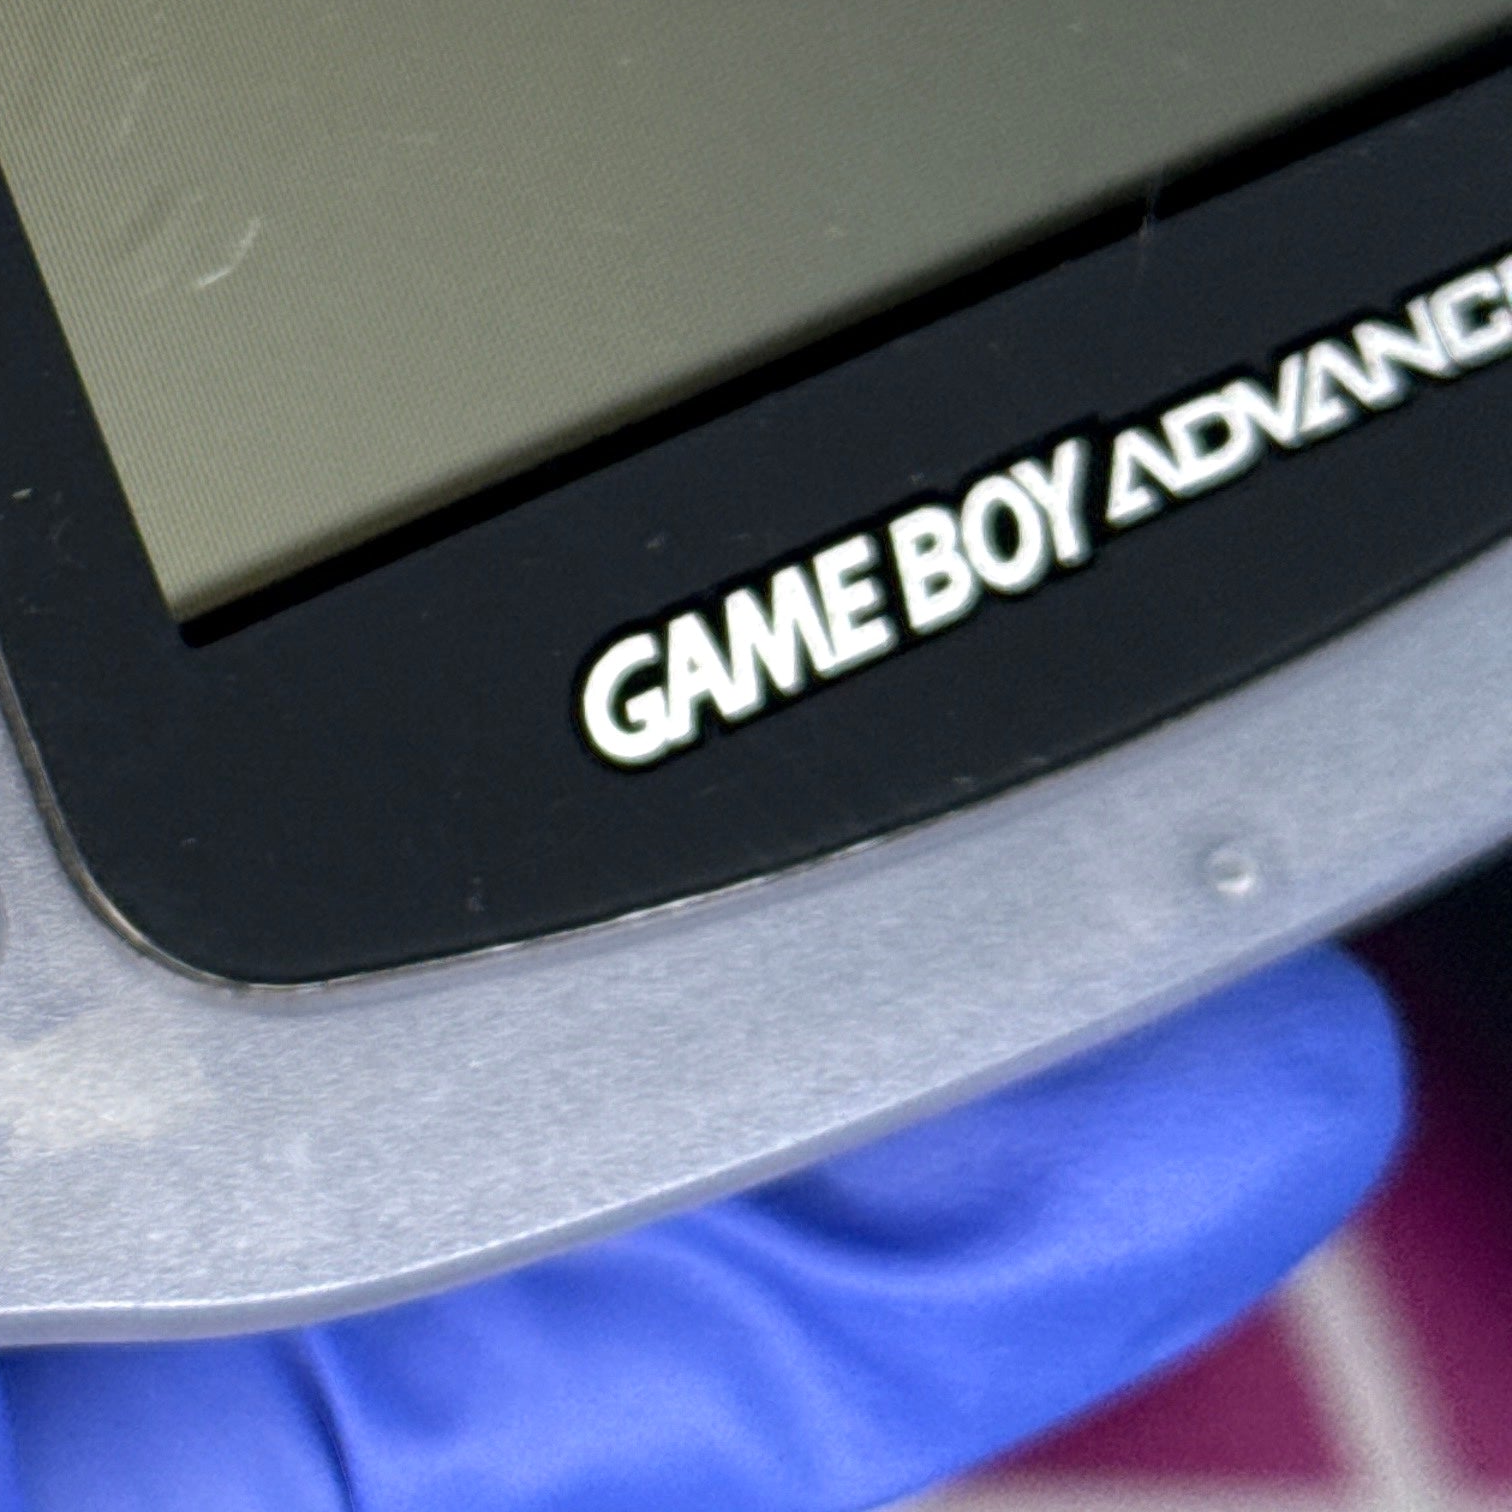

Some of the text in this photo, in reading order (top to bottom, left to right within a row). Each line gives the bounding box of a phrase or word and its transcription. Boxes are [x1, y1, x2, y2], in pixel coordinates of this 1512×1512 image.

[582, 252, 1512, 767] GAME BOY ADVANC
